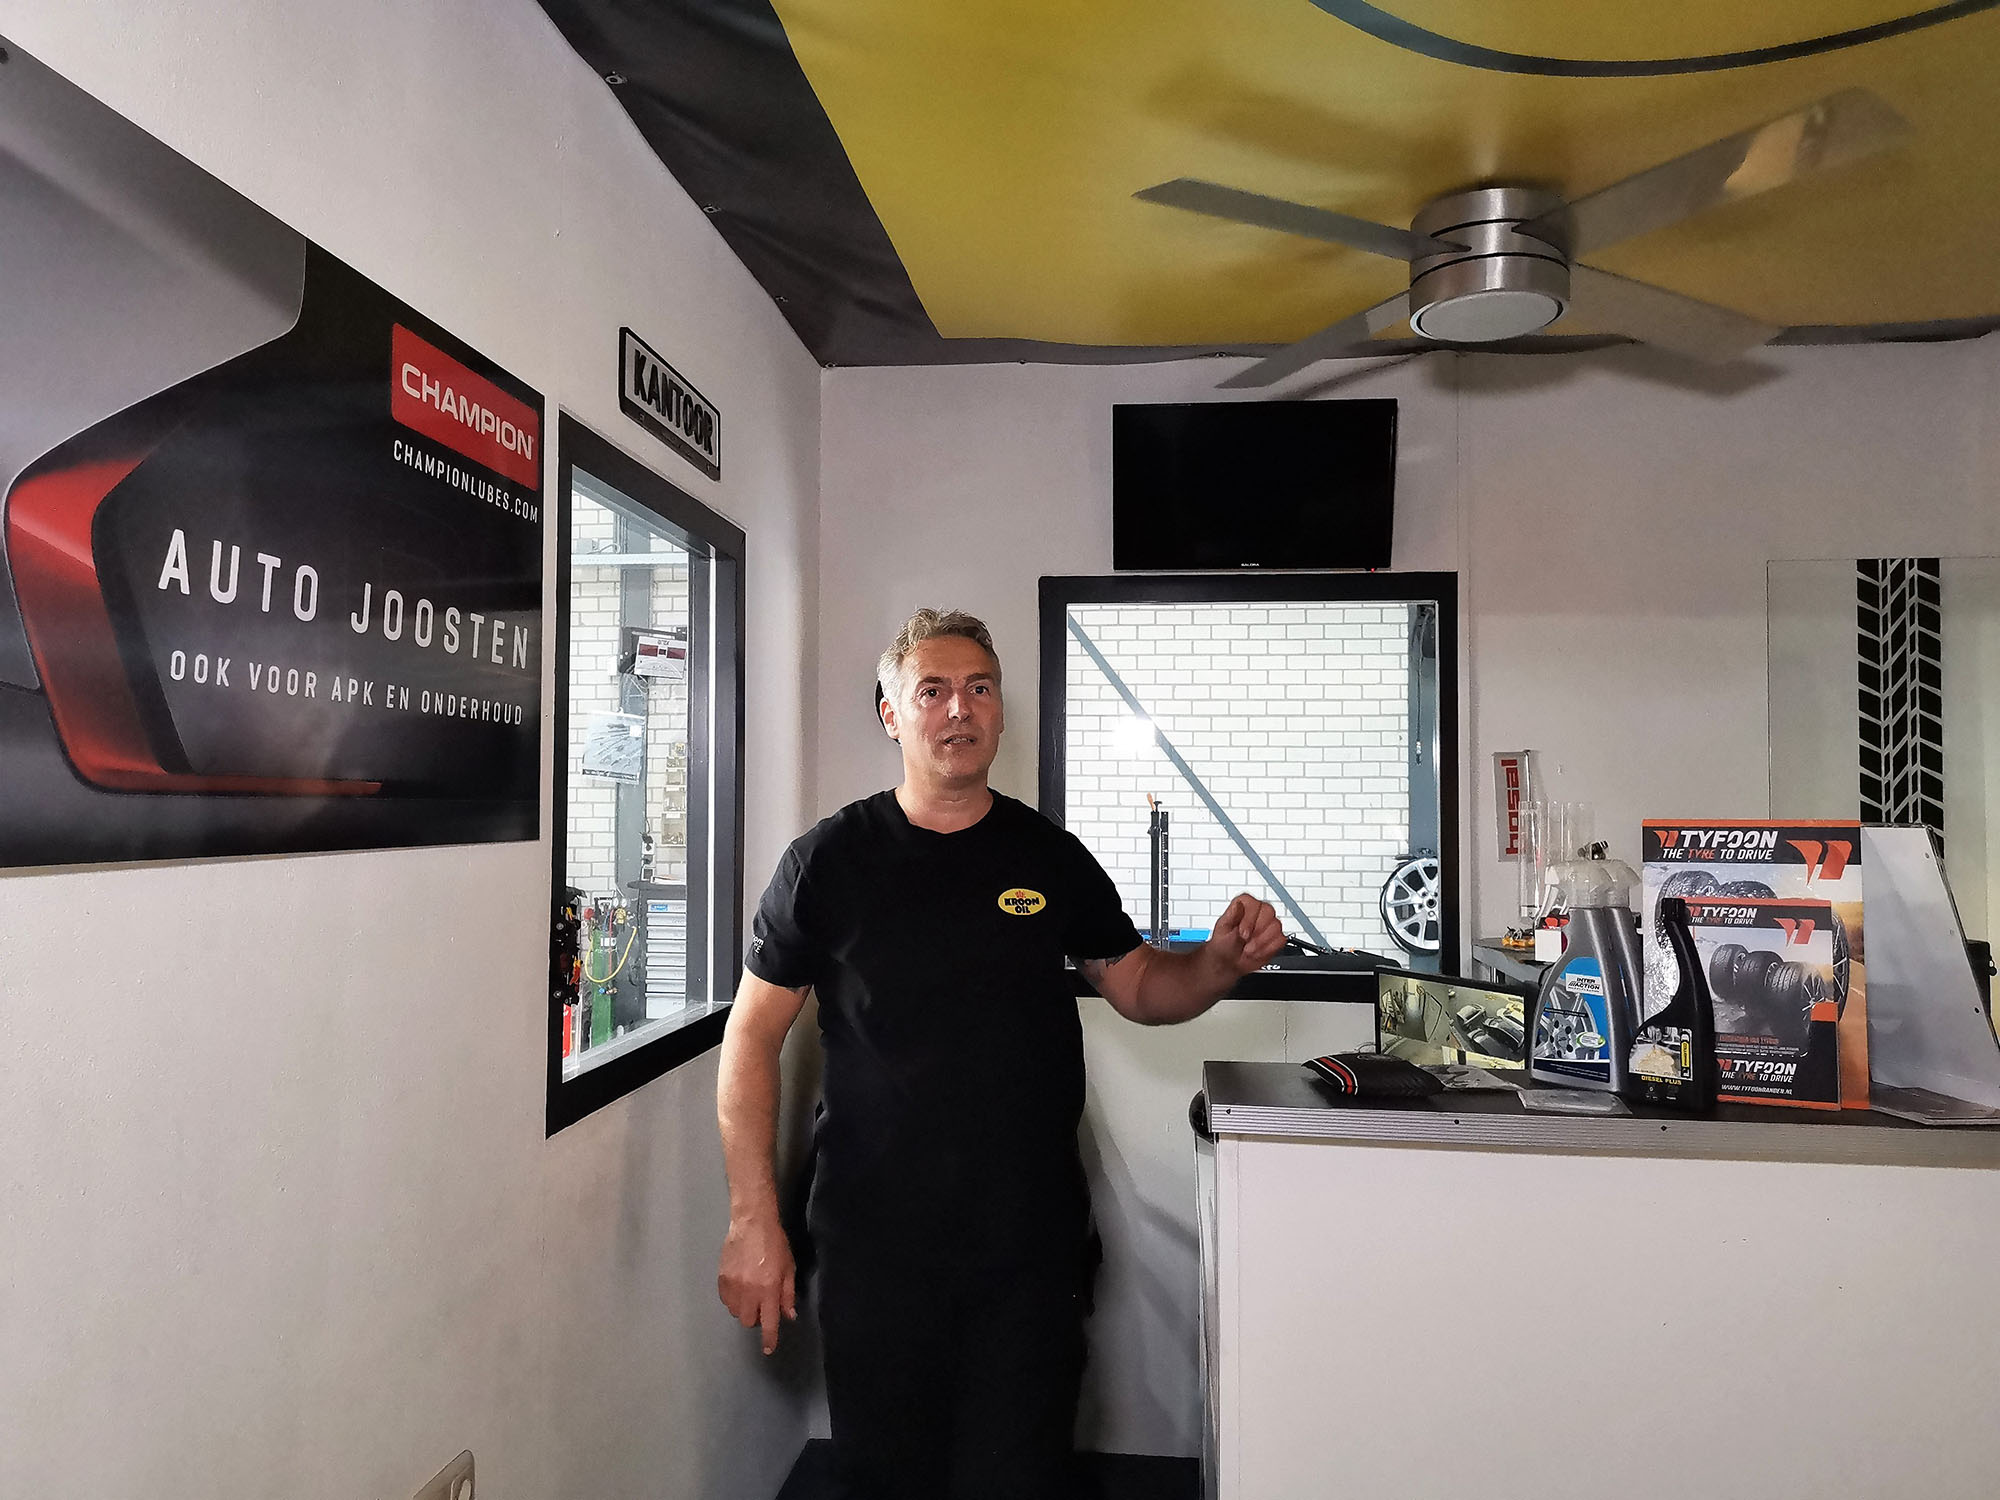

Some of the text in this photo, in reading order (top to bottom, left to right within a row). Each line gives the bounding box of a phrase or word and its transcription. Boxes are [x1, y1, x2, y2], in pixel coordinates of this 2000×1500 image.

[633, 348, 714, 456] KANTOOR
[402, 362, 533, 461] CHAMPION
[393, 439, 539, 524] CHAMPIONLUBES.COM
[158, 528, 529, 670] AUTO JOOSTEN
[169, 649, 524, 727] OOK VOOR APK EN ONDERHOUD
[1680, 830, 1778, 848] TYFOON
[1662, 848, 1773, 860] THE TYRE TO DRIVE
[1004, 897, 1040, 906] KROON
[1014, 905, 1031, 913] OIL
[1702, 906, 1758, 919] TYFOON
[1724, 917, 1733, 925] TO
[1733, 917, 1755, 926] DRIVE
[1574, 982, 1600, 990] ACTION
[1733, 1059, 1798, 1075] TYFOON
[1721, 1071, 1736, 1080] THE
[1759, 1073, 1769, 1081] TO
[1770, 1074, 1794, 1083] DRIVE
